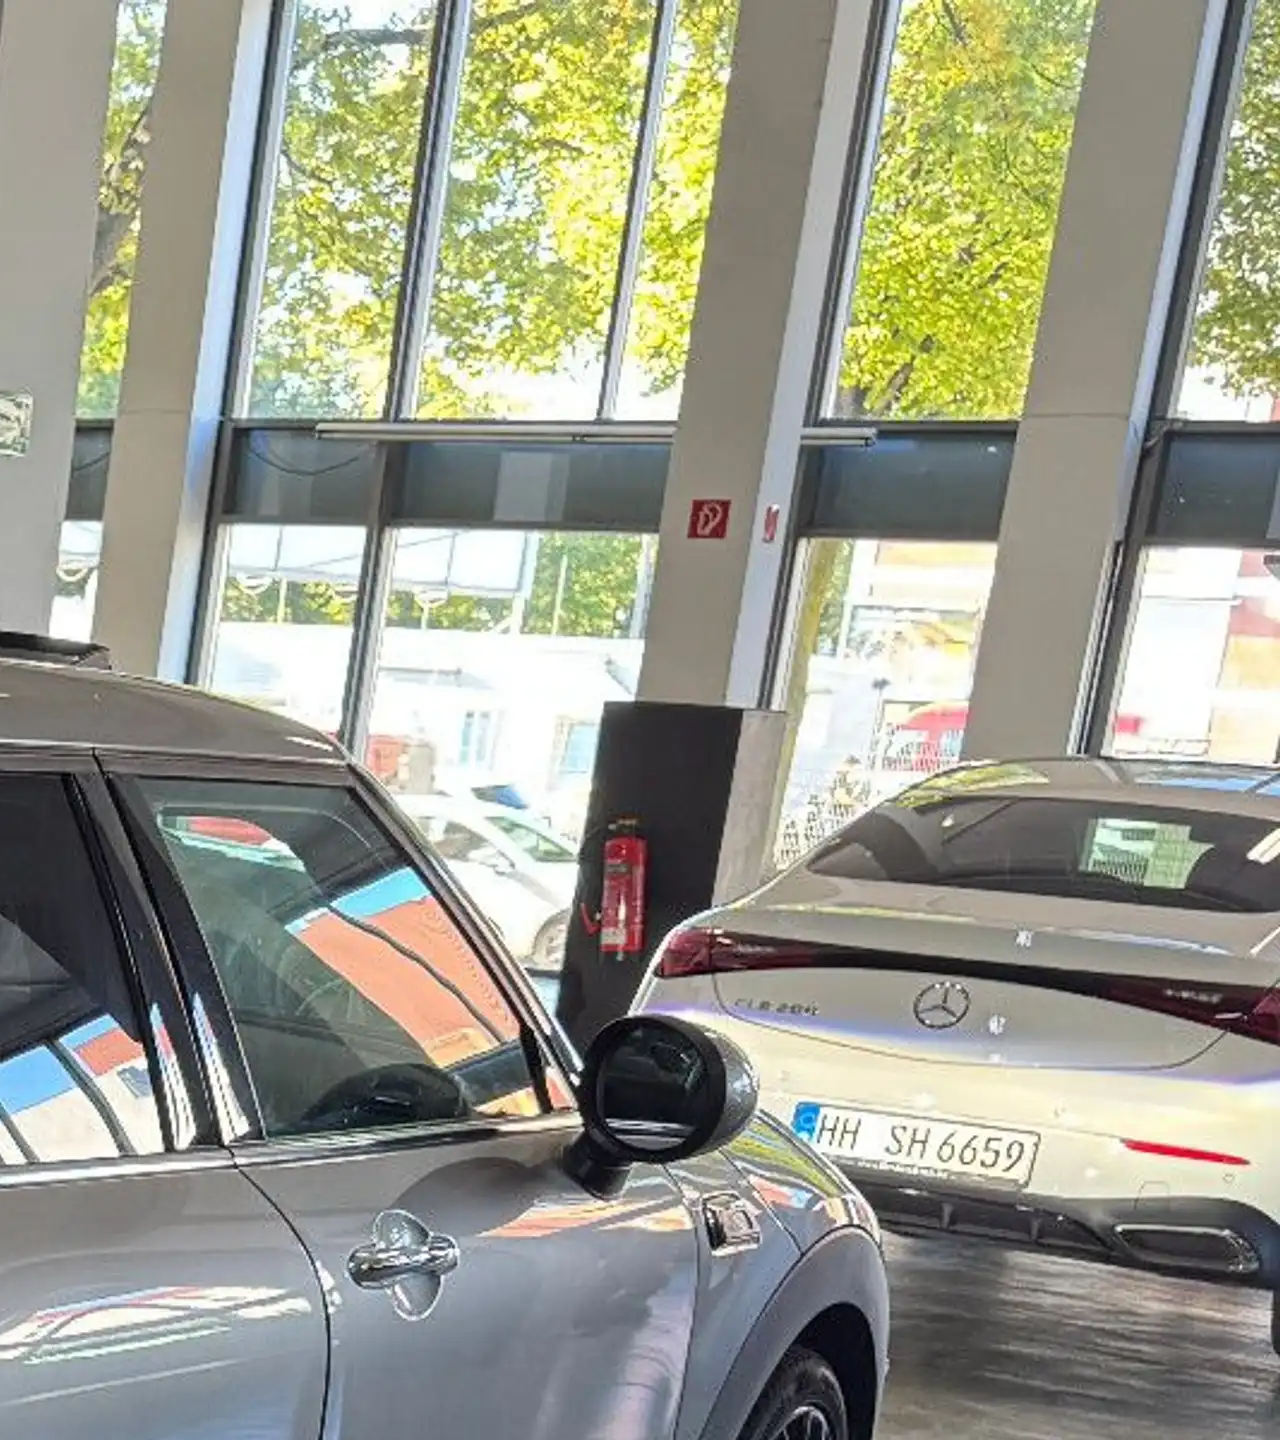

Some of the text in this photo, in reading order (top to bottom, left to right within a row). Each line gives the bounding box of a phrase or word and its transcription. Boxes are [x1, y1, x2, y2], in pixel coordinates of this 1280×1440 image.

[816, 1113, 862, 1151] HH
[884, 1124, 931, 1160] SH
[937, 1130, 1025, 1173] 6659
